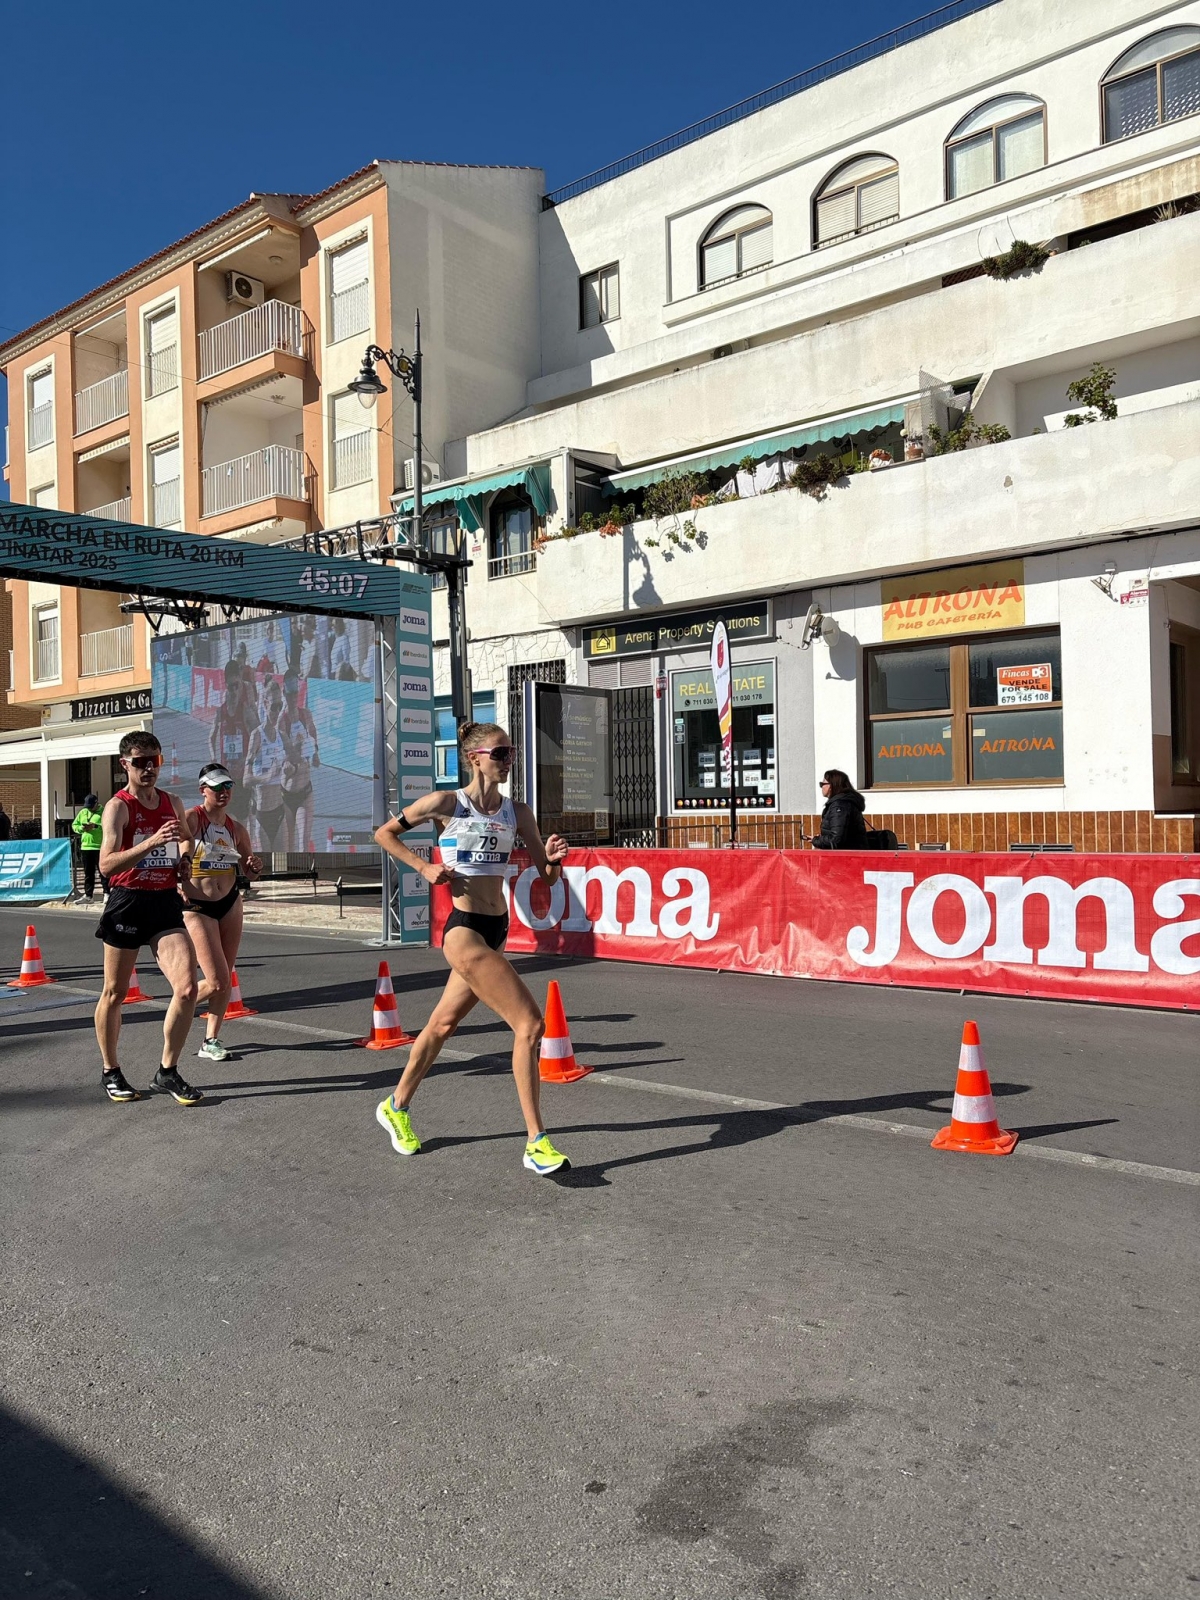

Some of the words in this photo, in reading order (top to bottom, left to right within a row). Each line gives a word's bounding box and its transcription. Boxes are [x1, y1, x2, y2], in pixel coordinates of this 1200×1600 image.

[0, 512, 98, 547] MARCHA
[103, 529, 130, 551] EN
[134, 534, 186, 560] RUTA
[190, 544, 211, 563] 20
[215, 547, 244, 568] KM
[79, 551, 117, 571] 2025
[298, 565, 370, 599] 45:07
[883, 578, 1023, 621] ALTRONA
[624, 631, 656, 644] Arena
[659, 624, 704, 640] Property
[706, 615, 761, 634] Sutions
[896, 620, 924, 631] PUB
[926, 609, 1002, 627] CAFETERÍA
[1002, 669, 1030, 679] Fincas
[1009, 678, 1041, 687] VENDE
[679, 682, 713, 697] REAL
[732, 675, 766, 692] TATE
[1002, 685, 1021, 693] FOR
[1023, 683, 1048, 691] SALE
[78, 697, 120, 718] Pizzeria
[1001, 695, 1016, 704] 679
[1018, 694, 1033, 703] 145
[1035, 692, 1049, 701] 108
[878, 742, 946, 759] ALTRONA
[979, 736, 1056, 754] ALTRONA
[479, 836, 498, 850] 79
[0, 852, 44, 874] EA
[216, 853, 225, 861] 3
